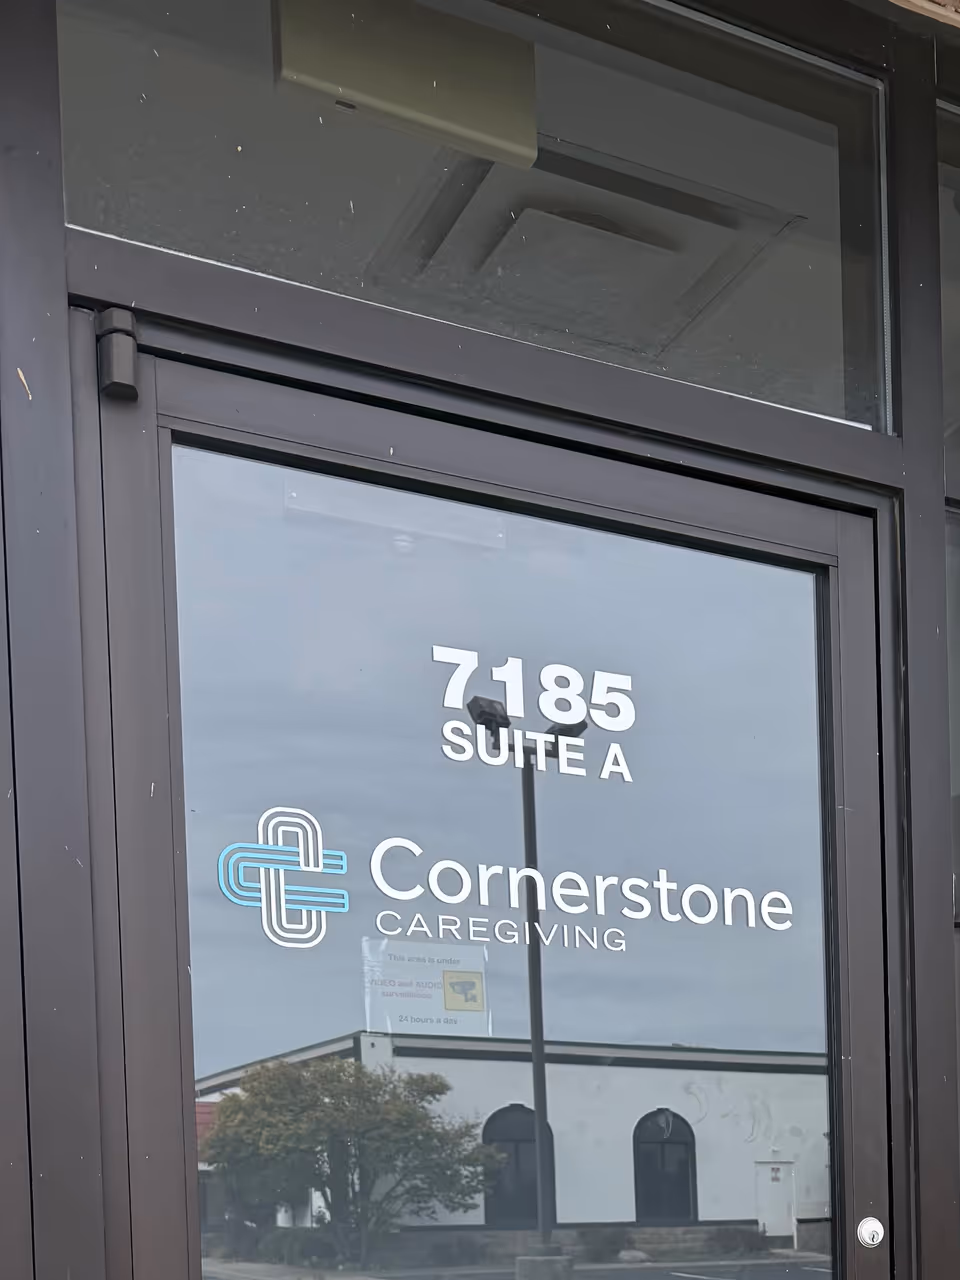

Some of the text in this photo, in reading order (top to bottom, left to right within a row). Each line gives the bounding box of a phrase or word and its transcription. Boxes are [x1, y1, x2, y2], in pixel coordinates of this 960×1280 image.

[432, 645, 636, 732] 7185
[441, 720, 634, 783] SUITE A
[369, 837, 793, 932] Cornerstone
[376, 910, 627, 952] CAREGIVING
